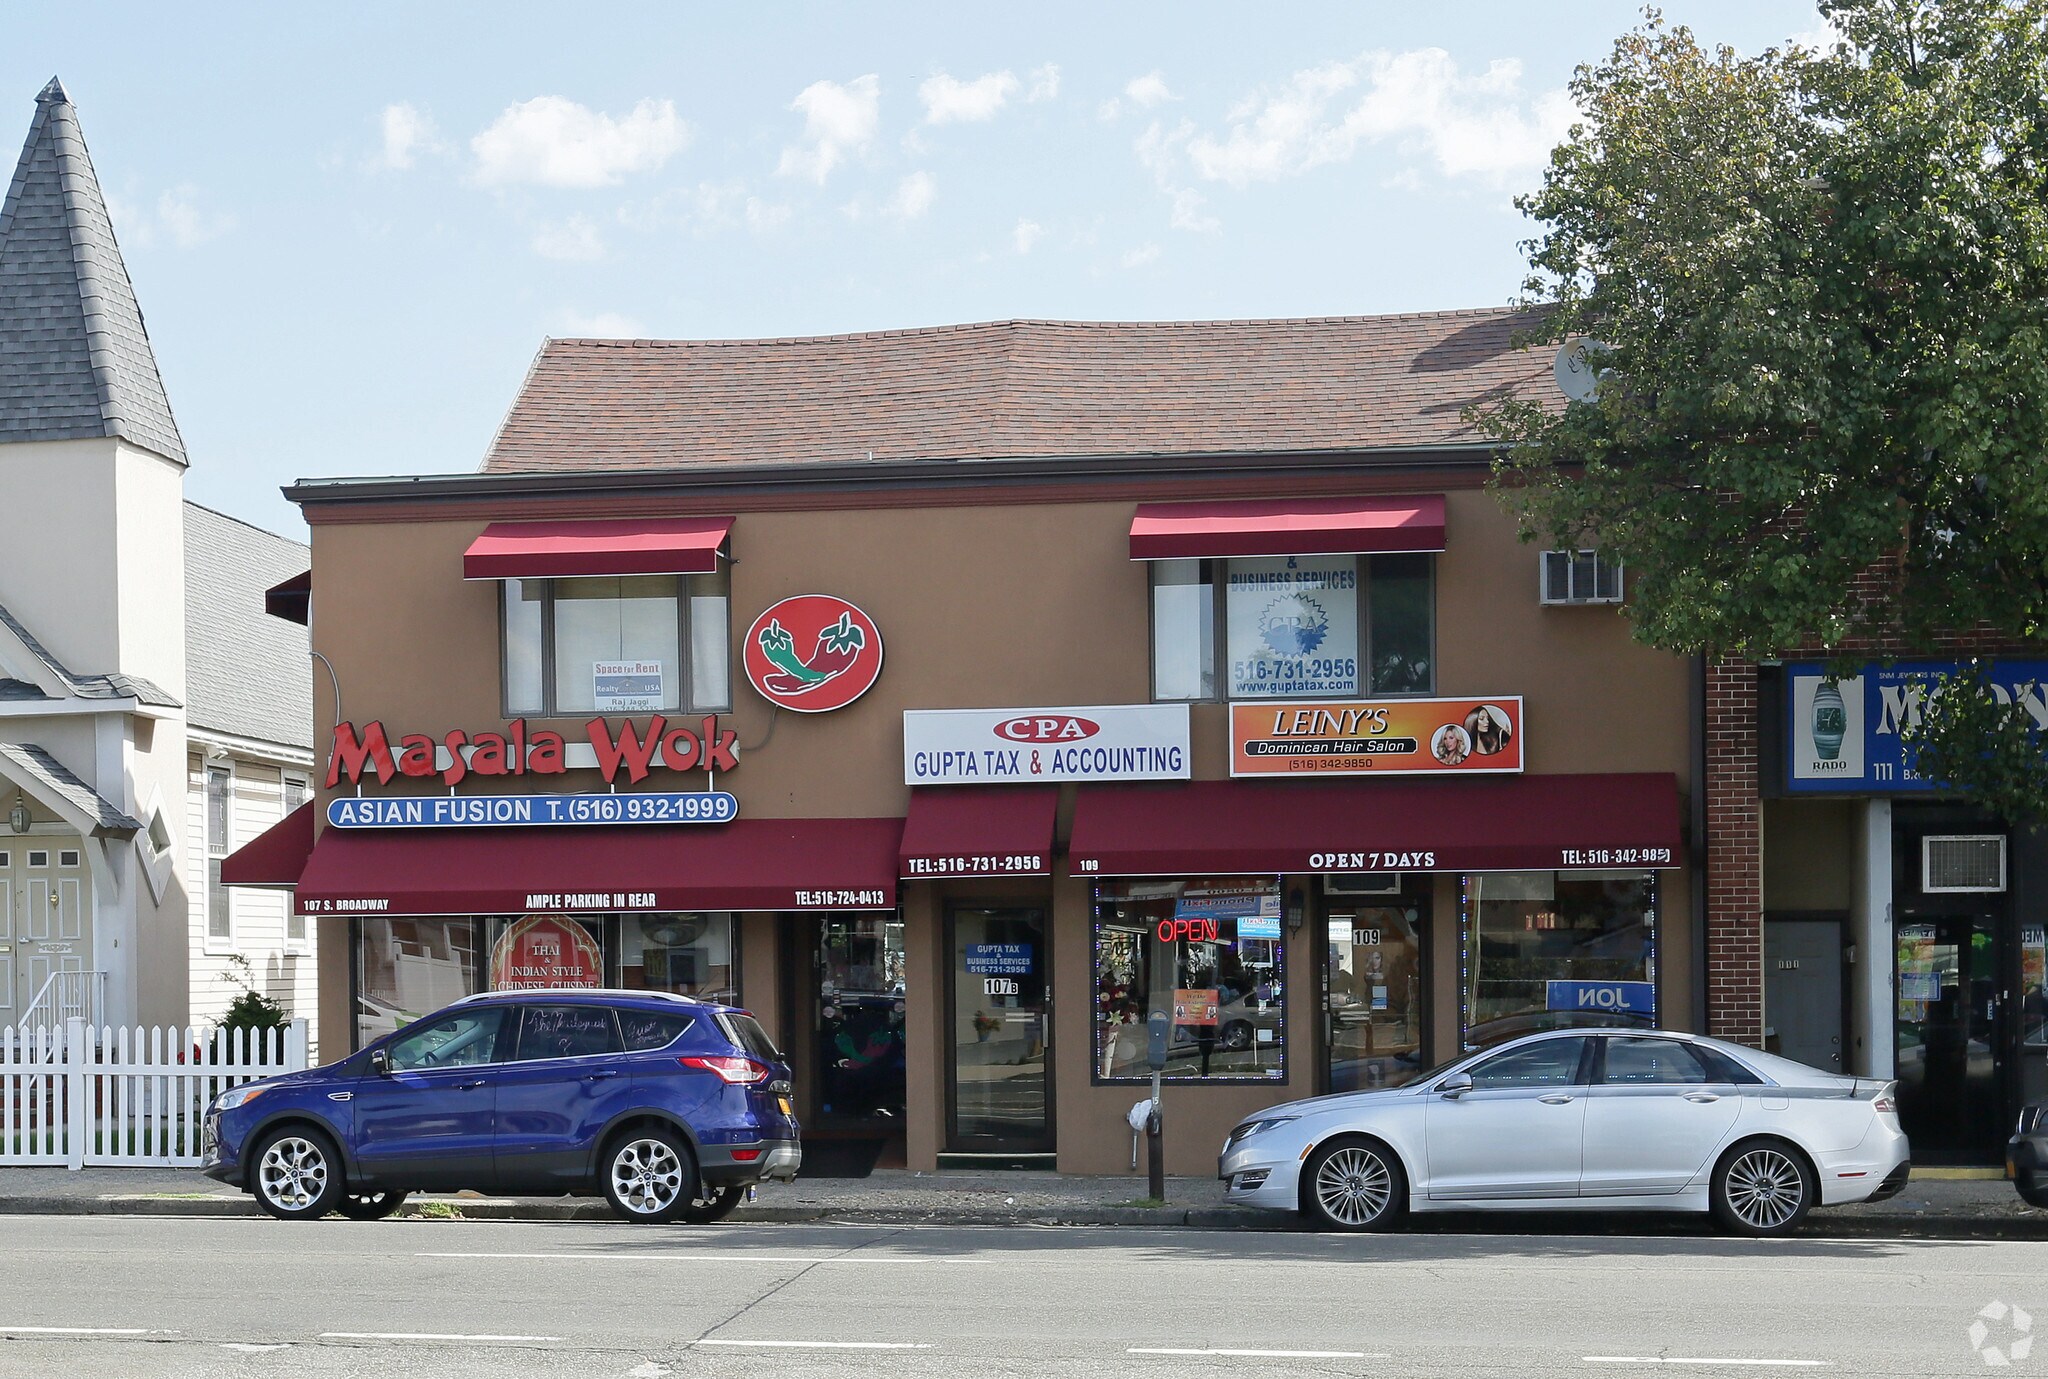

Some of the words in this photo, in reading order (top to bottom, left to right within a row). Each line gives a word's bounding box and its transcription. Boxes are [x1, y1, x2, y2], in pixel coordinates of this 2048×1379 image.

[1287, 556, 1297, 569] &
[1231, 572, 1291, 592] BUSINESS
[1295, 570, 1355, 590] SERVICES
[1269, 616, 1319, 634] CPA
[595, 663, 623, 675] Space
[635, 663, 659, 673] Rent
[1234, 659, 1356, 680] 516-731-2956
[1236, 680, 1354, 693] www.guptatax.com
[611, 698, 626, 706] Raj
[629, 698, 649, 707] Jaggi
[1004, 719, 1087, 739] CPA
[1271, 708, 1390, 736] LEINY'S
[324, 718, 567, 789] Masala
[586, 713, 739, 785] Wok
[1257, 741, 1329, 754] Dominican
[1333, 741, 1363, 753] Hair
[1367, 740, 1405, 752] Salon
[914, 751, 979, 777] GUPTA
[983, 750, 1020, 775] TAX
[1030, 749, 1042, 775] &
[1052, 746, 1182, 774] ACCOUNTING
[1288, 759, 1318, 771] (516)
[1320, 758, 1373, 769] 342-9850
[1812, 761, 1847, 770] RADO
[1873, 762, 1893, 781] 111
[338, 801, 423, 824] ASIAN
[434, 799, 531, 822] FUSION
[546, 799, 564, 821] T.
[569, 797, 622, 822] (516)
[628, 796, 730, 819] 932-1999
[908, 855, 1041, 874] TEL:516-731-2956
[1308, 853, 1365, 868] OPEN
[1368, 853, 1380, 868] 7
[1383, 851, 1435, 868] DAYS
[1560, 849, 1587, 865] TEL:
[1080, 860, 1099, 872] 109
[303, 900, 322, 911] 107
[323, 900, 334, 911] S.
[336, 899, 389, 911] BROADWAY
[526, 894, 562, 910] AMPLE
[564, 894, 611, 909] PARKING
[613, 894, 625, 908] IN
[628, 893, 656, 908] REAR
[795, 890, 884, 906] TEL:516-724-0413
[1157, 918, 1220, 943] OPEN
[1354, 929, 1380, 945] 109
[532, 945, 560, 956] THAI
[977, 945, 1003, 954] GUPTA
[1004, 945, 1020, 953] TAX
[510, 967, 547, 977] INDIAN
[552, 966, 583, 976] STYLE
[498, 981, 545, 990] CHINESE
[551, 981, 594, 989] CUISINE
